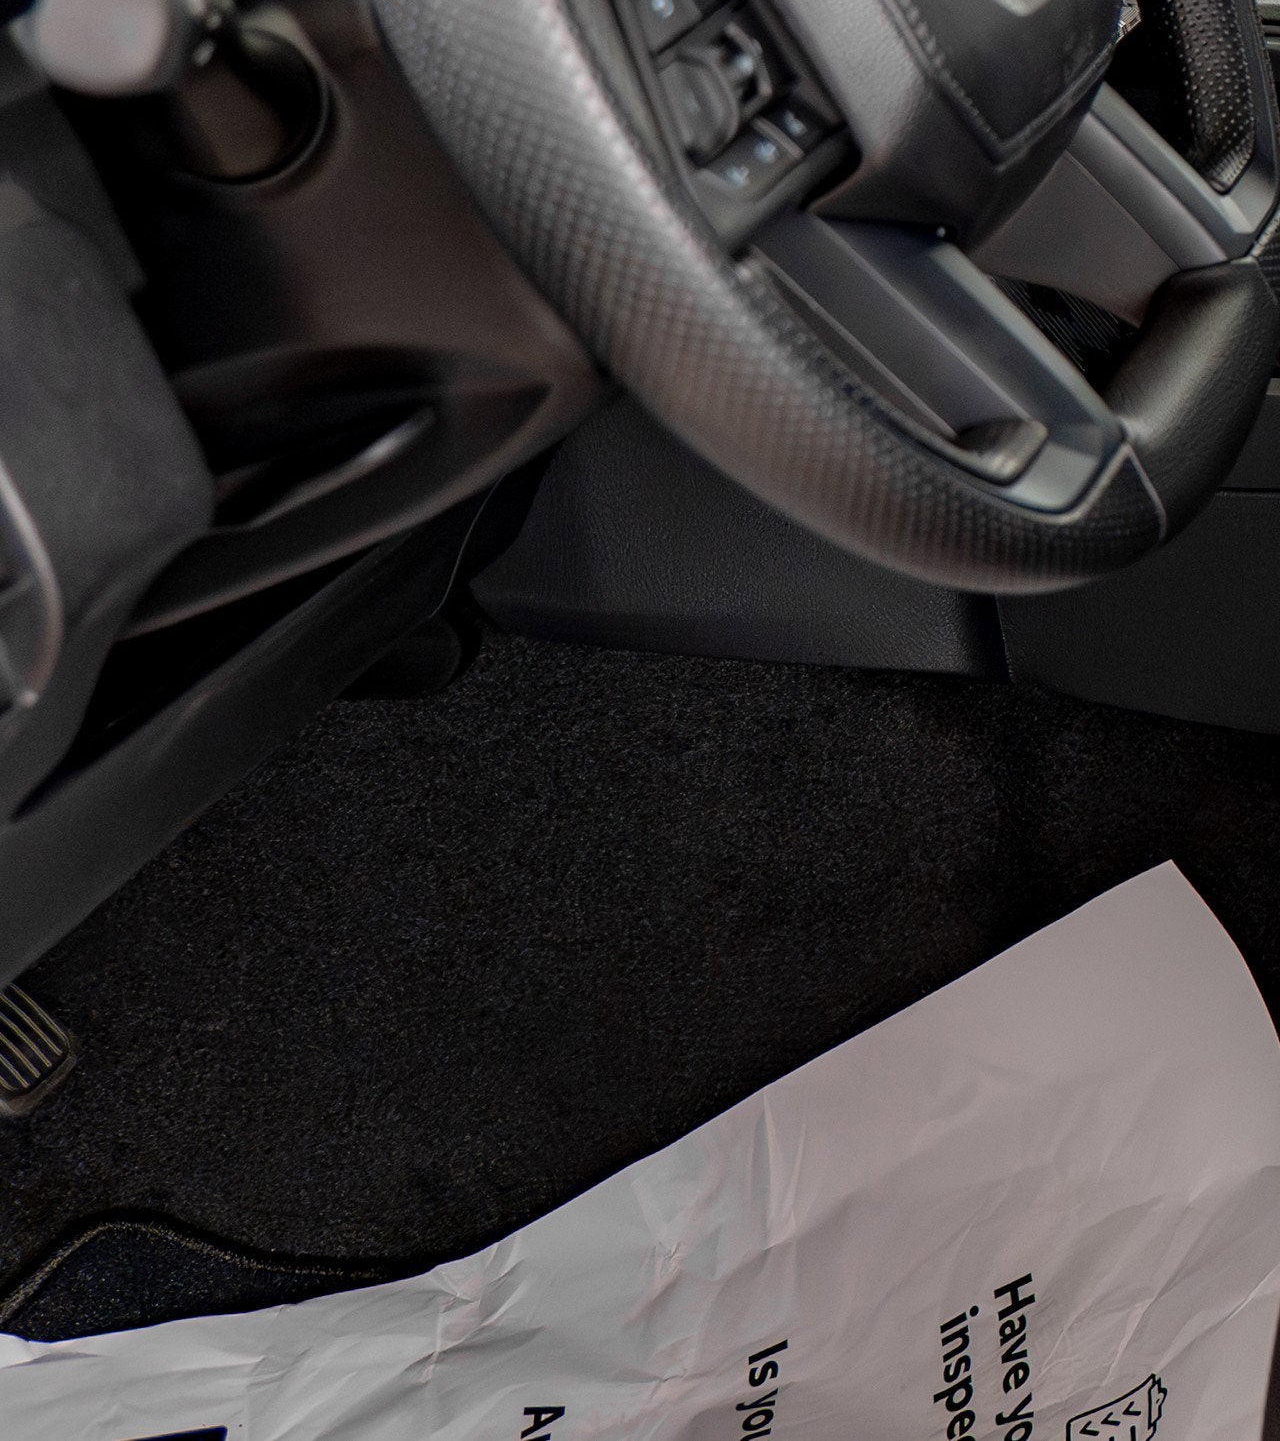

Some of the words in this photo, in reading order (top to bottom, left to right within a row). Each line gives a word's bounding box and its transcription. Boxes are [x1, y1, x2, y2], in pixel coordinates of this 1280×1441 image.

[748, 1339, 789, 1387] Is
[933, 1305, 980, 1441] inspe
[994, 1272, 1036, 1394] Have
[520, 1405, 566, 1441] A
